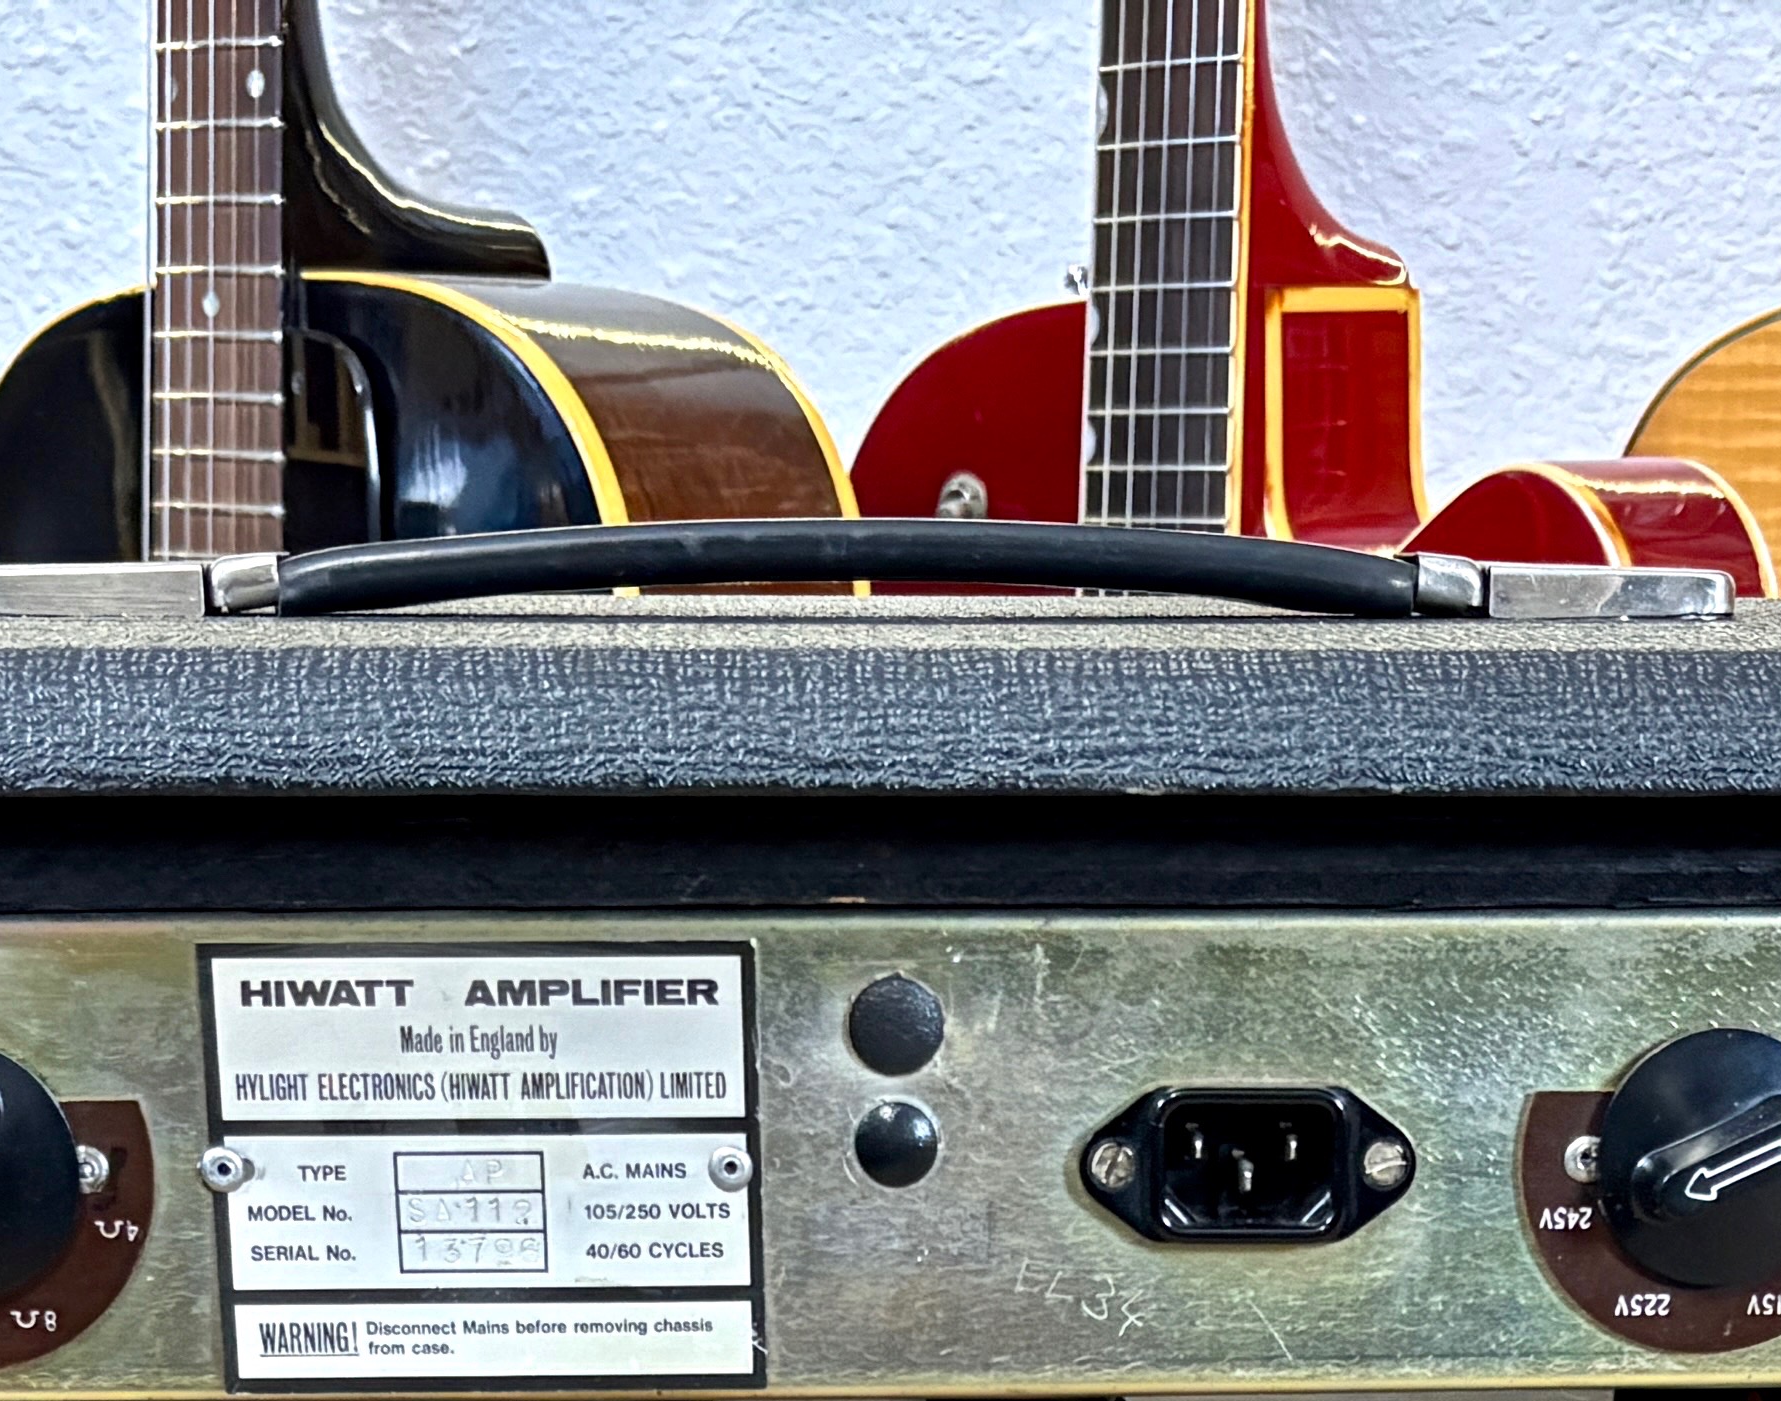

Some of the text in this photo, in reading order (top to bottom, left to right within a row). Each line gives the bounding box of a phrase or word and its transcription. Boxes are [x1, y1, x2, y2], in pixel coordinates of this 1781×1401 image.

[240, 979, 719, 1007] HIWATT AMPLIFIER
[400, 1024, 558, 1060] Made in England by
[235, 1069, 727, 1103] HYLIGHT ELECTRONICS (HIWATT AMPLIFICATION) LIMITED
[297, 1165, 347, 1182] TYPE
[582, 1162, 687, 1179] A.C. MAINS
[248, 1205, 352, 1222] MODEL No.
[584, 1203, 730, 1220] 105/250 VOLTS
[1539, 1207, 1593, 1230] 245V
[251, 1244, 356, 1262] SERIAL No.
[586, 1242, 724, 1260] 40/60 CYCLES
[1614, 1293, 1671, 1317] 225V
[259, 1317, 714, 1354] WARNING! Disconnect Mains before removing chassis
[368, 1341, 455, 1355] from case.
